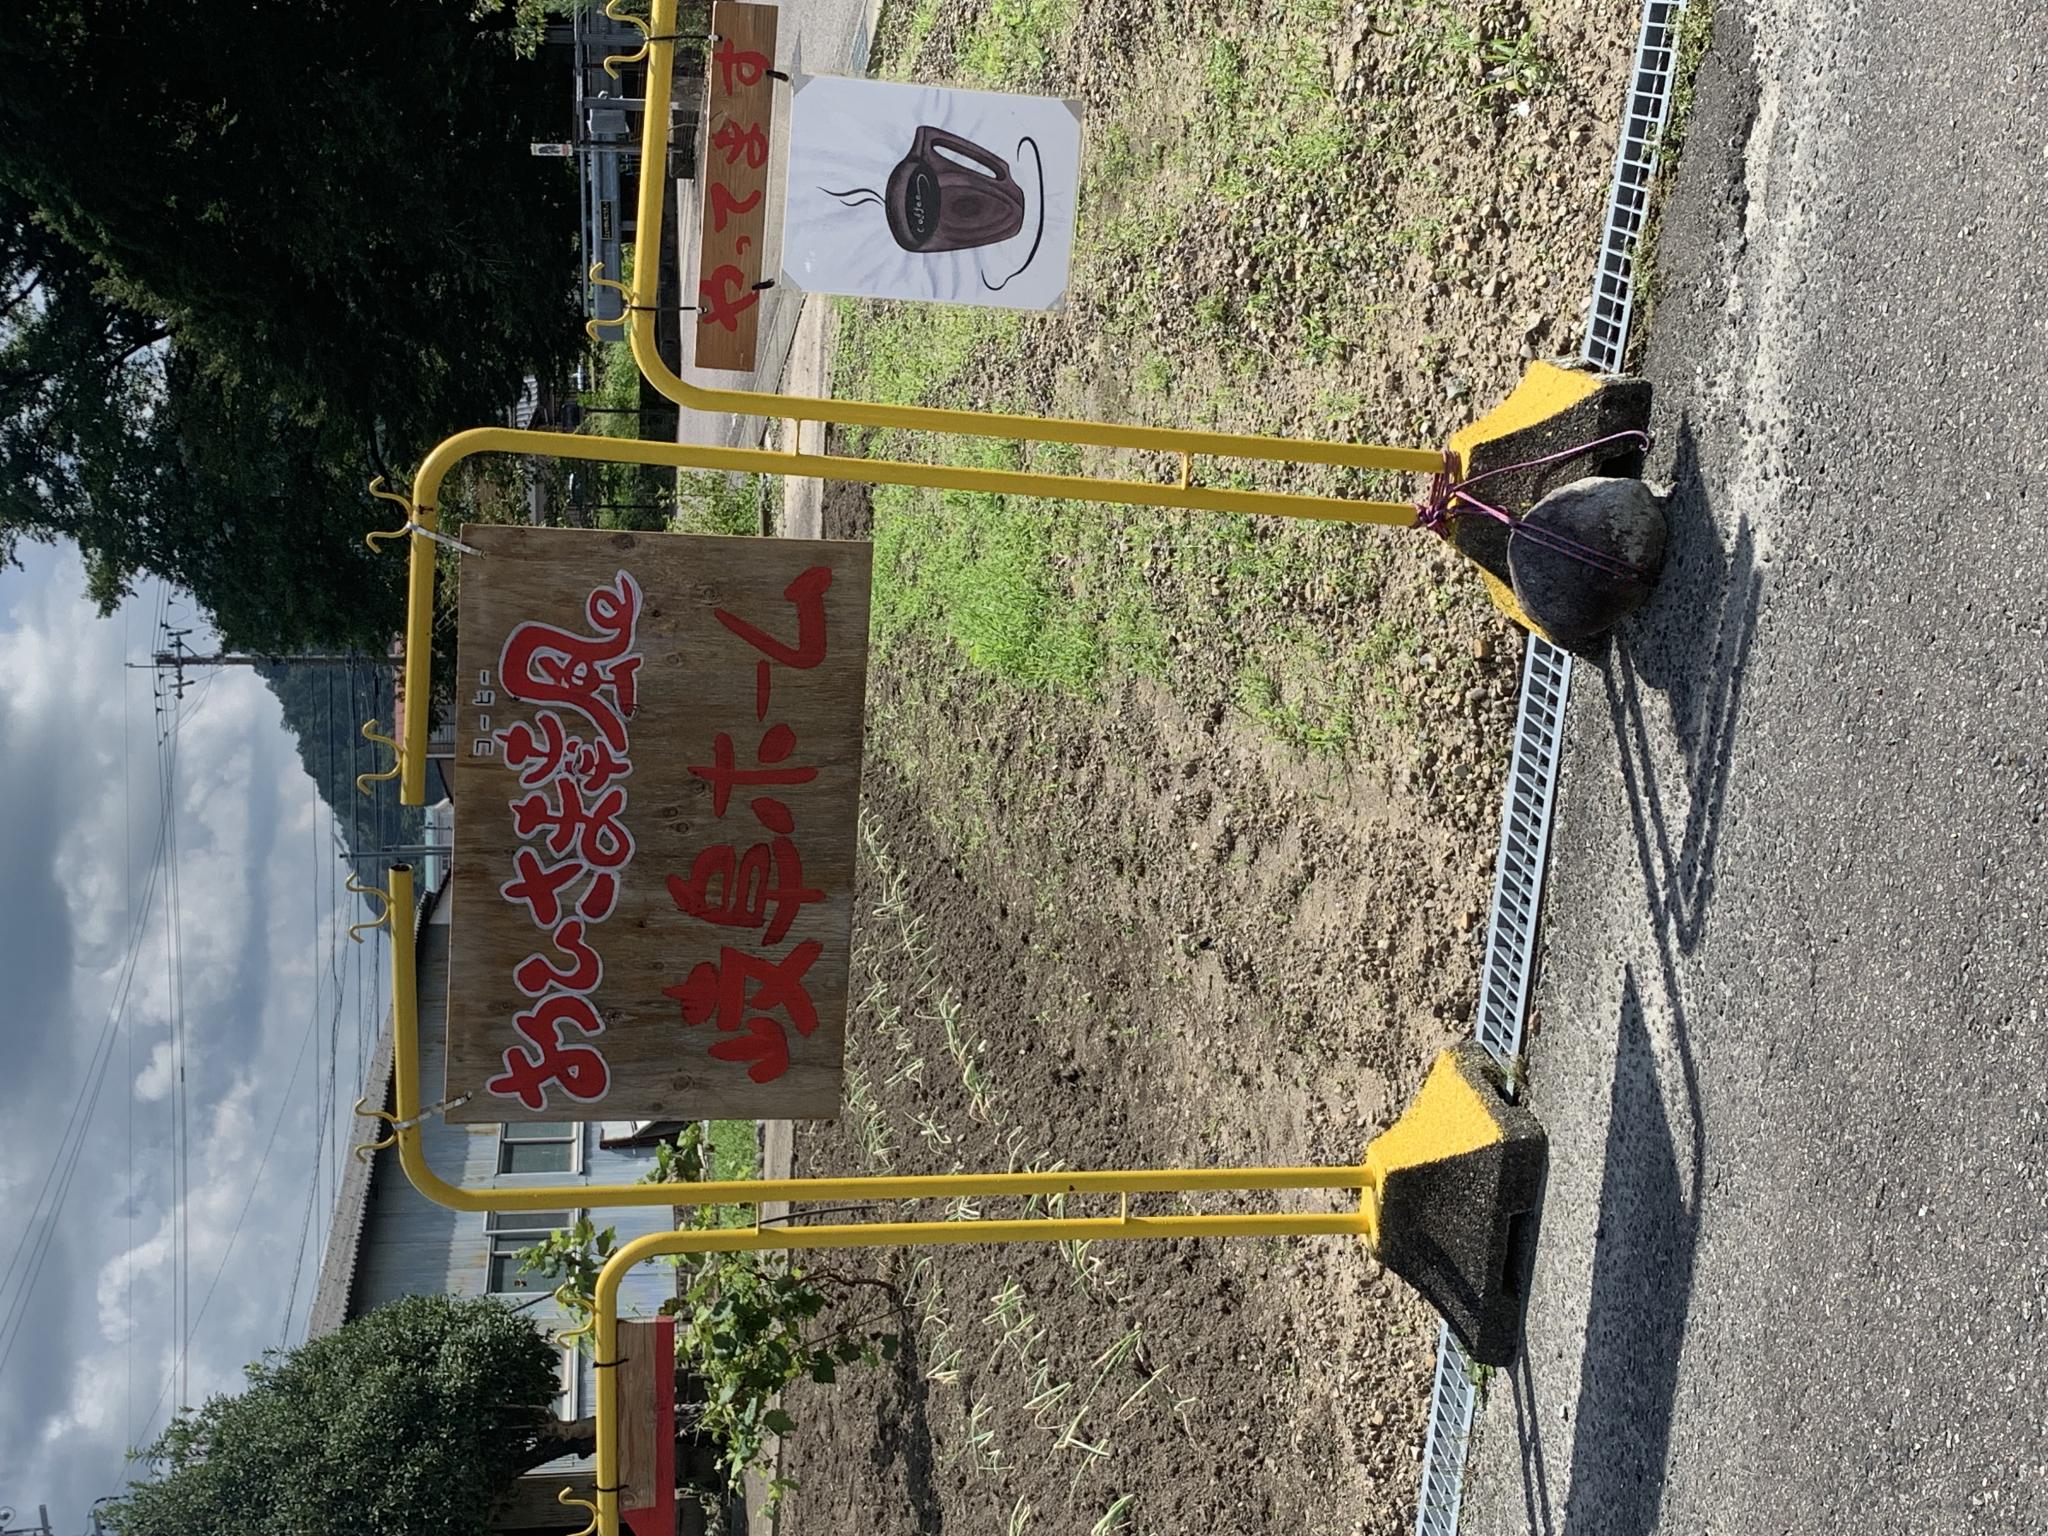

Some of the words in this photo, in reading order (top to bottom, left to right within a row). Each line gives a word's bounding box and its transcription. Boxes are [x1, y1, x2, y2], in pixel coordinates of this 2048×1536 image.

[700, 40, 770, 331] やってます
[472, 669, 494, 756] コーヒー
[661, 567, 833, 1084] 岐阜ホーム
